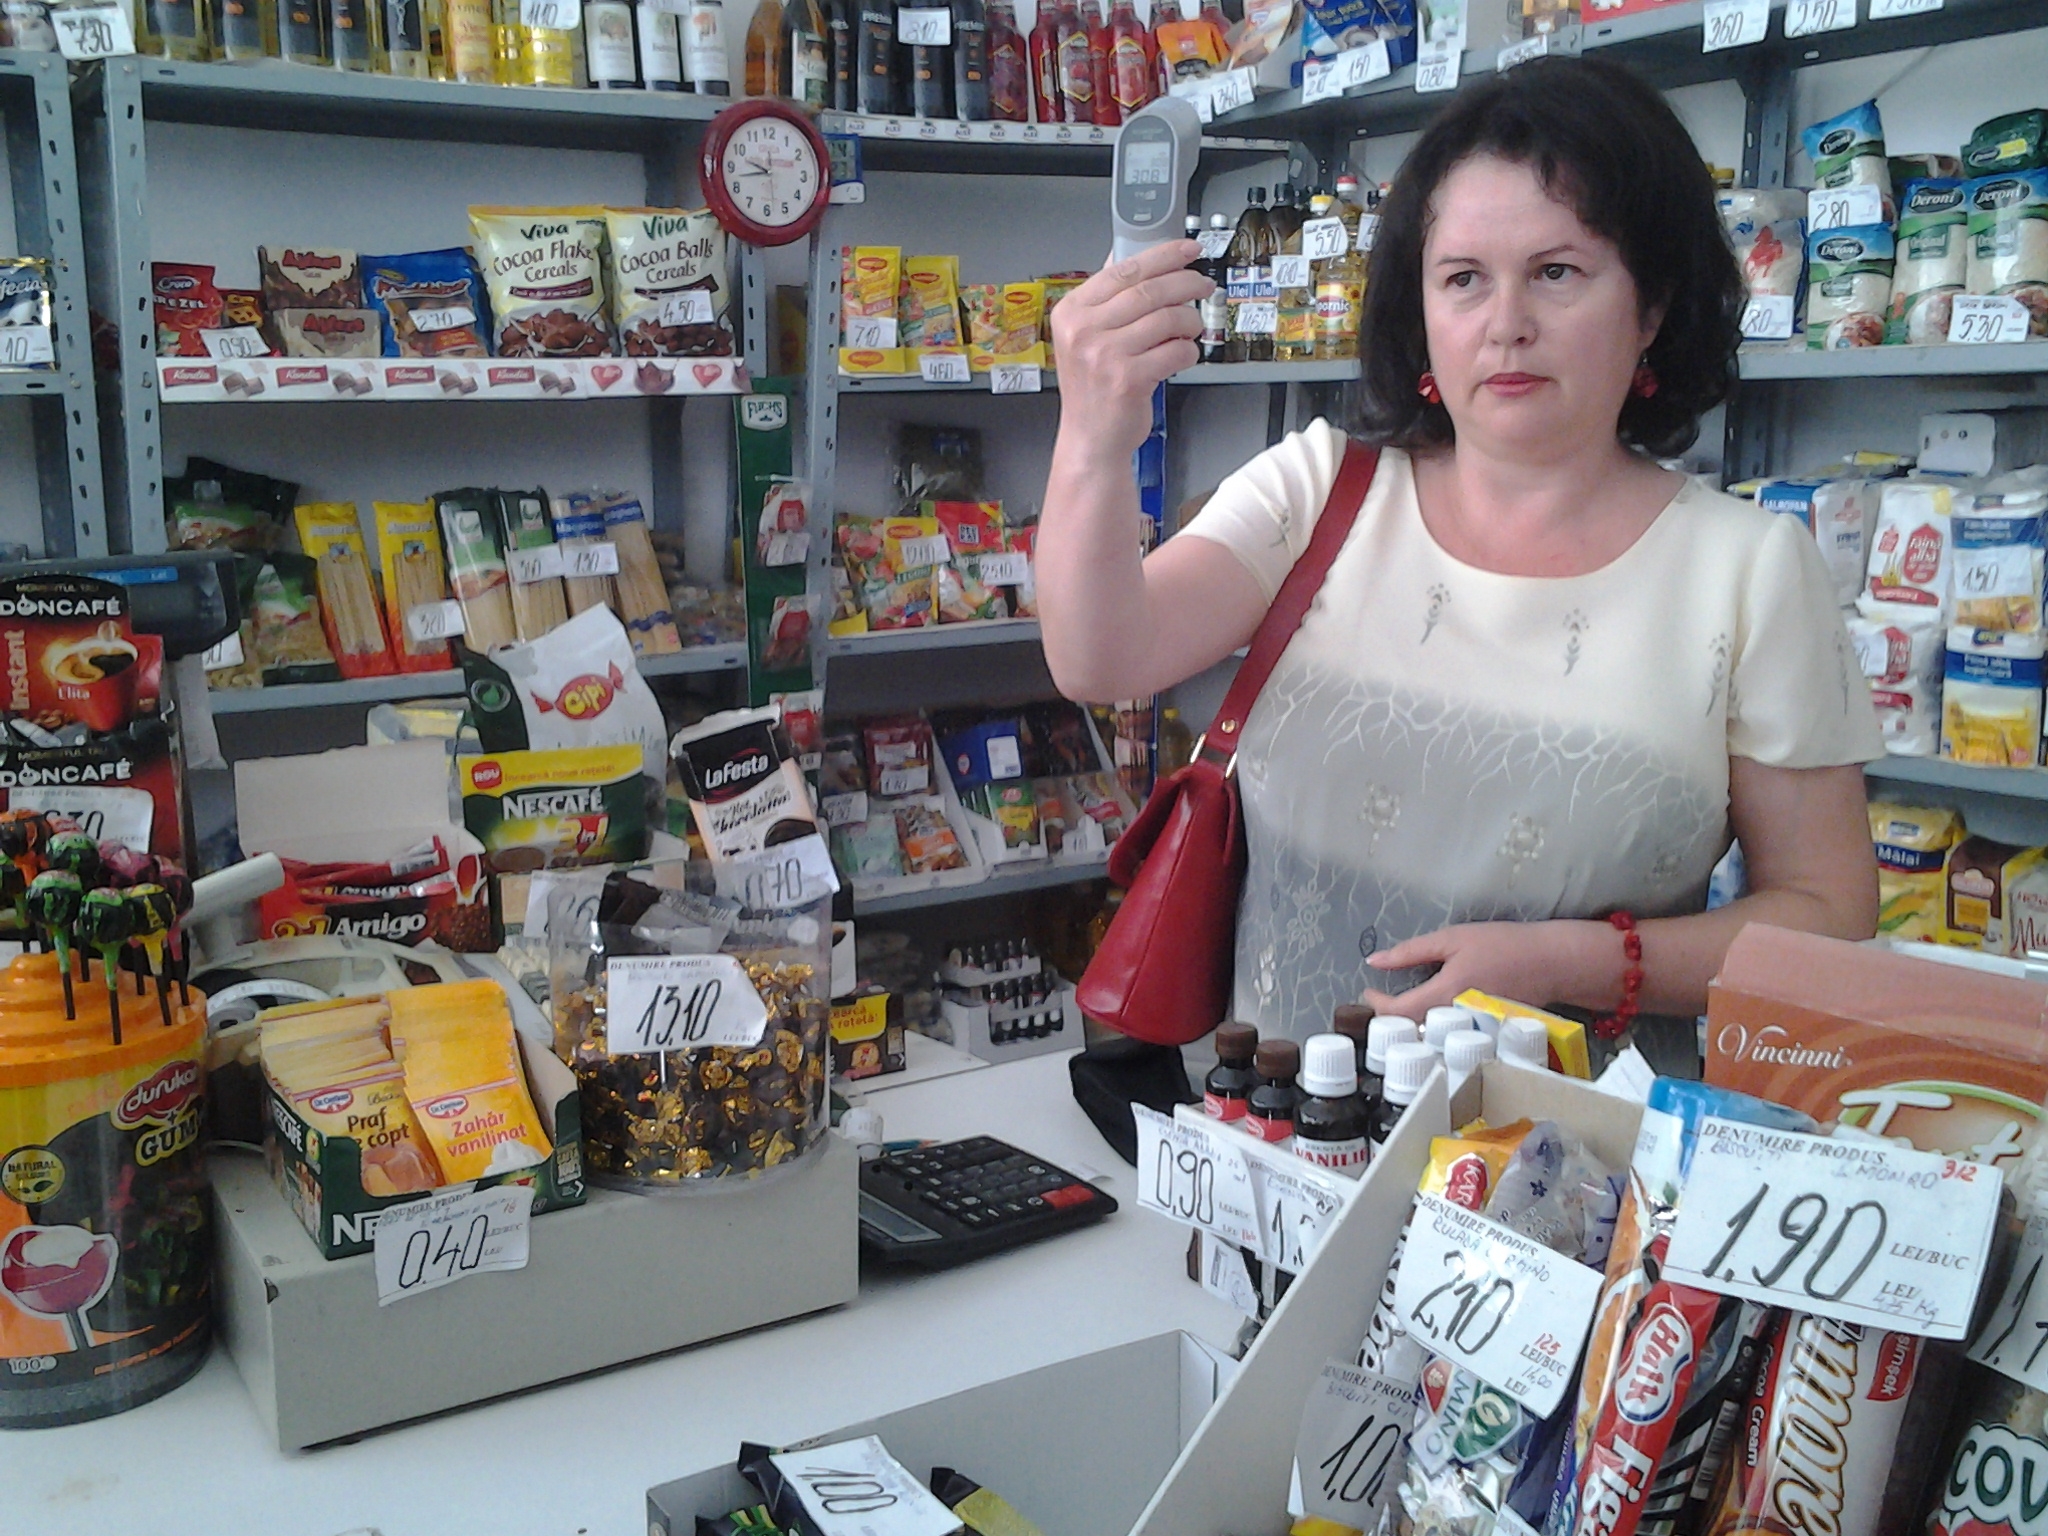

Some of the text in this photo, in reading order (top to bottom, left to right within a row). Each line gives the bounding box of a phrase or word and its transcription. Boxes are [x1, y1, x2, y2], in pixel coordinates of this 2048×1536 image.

[747, 131, 759, 143] 11
[762, 127, 776, 140] 12
[783, 135, 790, 148] 1
[733, 143, 746, 157] 10
[794, 148, 803, 162] 2
[727, 160, 736, 174] 9
[800, 170, 808, 183] 3
[732, 181, 741, 194] 8
[793, 189, 801, 201] 4
[1976, 183, 2022, 204] Deroni
[745, 196, 754, 209] 7
[762, 204, 771, 217] 6
[780, 201, 789, 214] 5
[1910, 193, 1956, 208] Deroni
[520, 224, 569, 240] Viva
[643, 215, 688, 240] Viva
[493, 247, 544, 276] Cocoa
[620, 236, 714, 274] Cocoa Balls
[524, 260, 578, 282] Cereals
[646, 263, 698, 283] Cereals
[1228, 284, 1249, 299] Ulei
[0, 757, 133, 787] DONCAFÉ
[501, 784, 605, 822] NESCAFÉ
[333, 911, 428, 938] Amigo
[346, 1106, 388, 1132] Praf
[450, 1110, 505, 1138] Zahăr
[140, 1111, 199, 1161] GUM
[366, 1122, 410, 1149] copt
[445, 1121, 528, 1158] vanilinat
[1702, 1122, 1807, 1157] DENUMIRE
[1421, 1196, 1487, 1234] DENUMIRE
[1747, 1405, 1766, 1468] Cream
